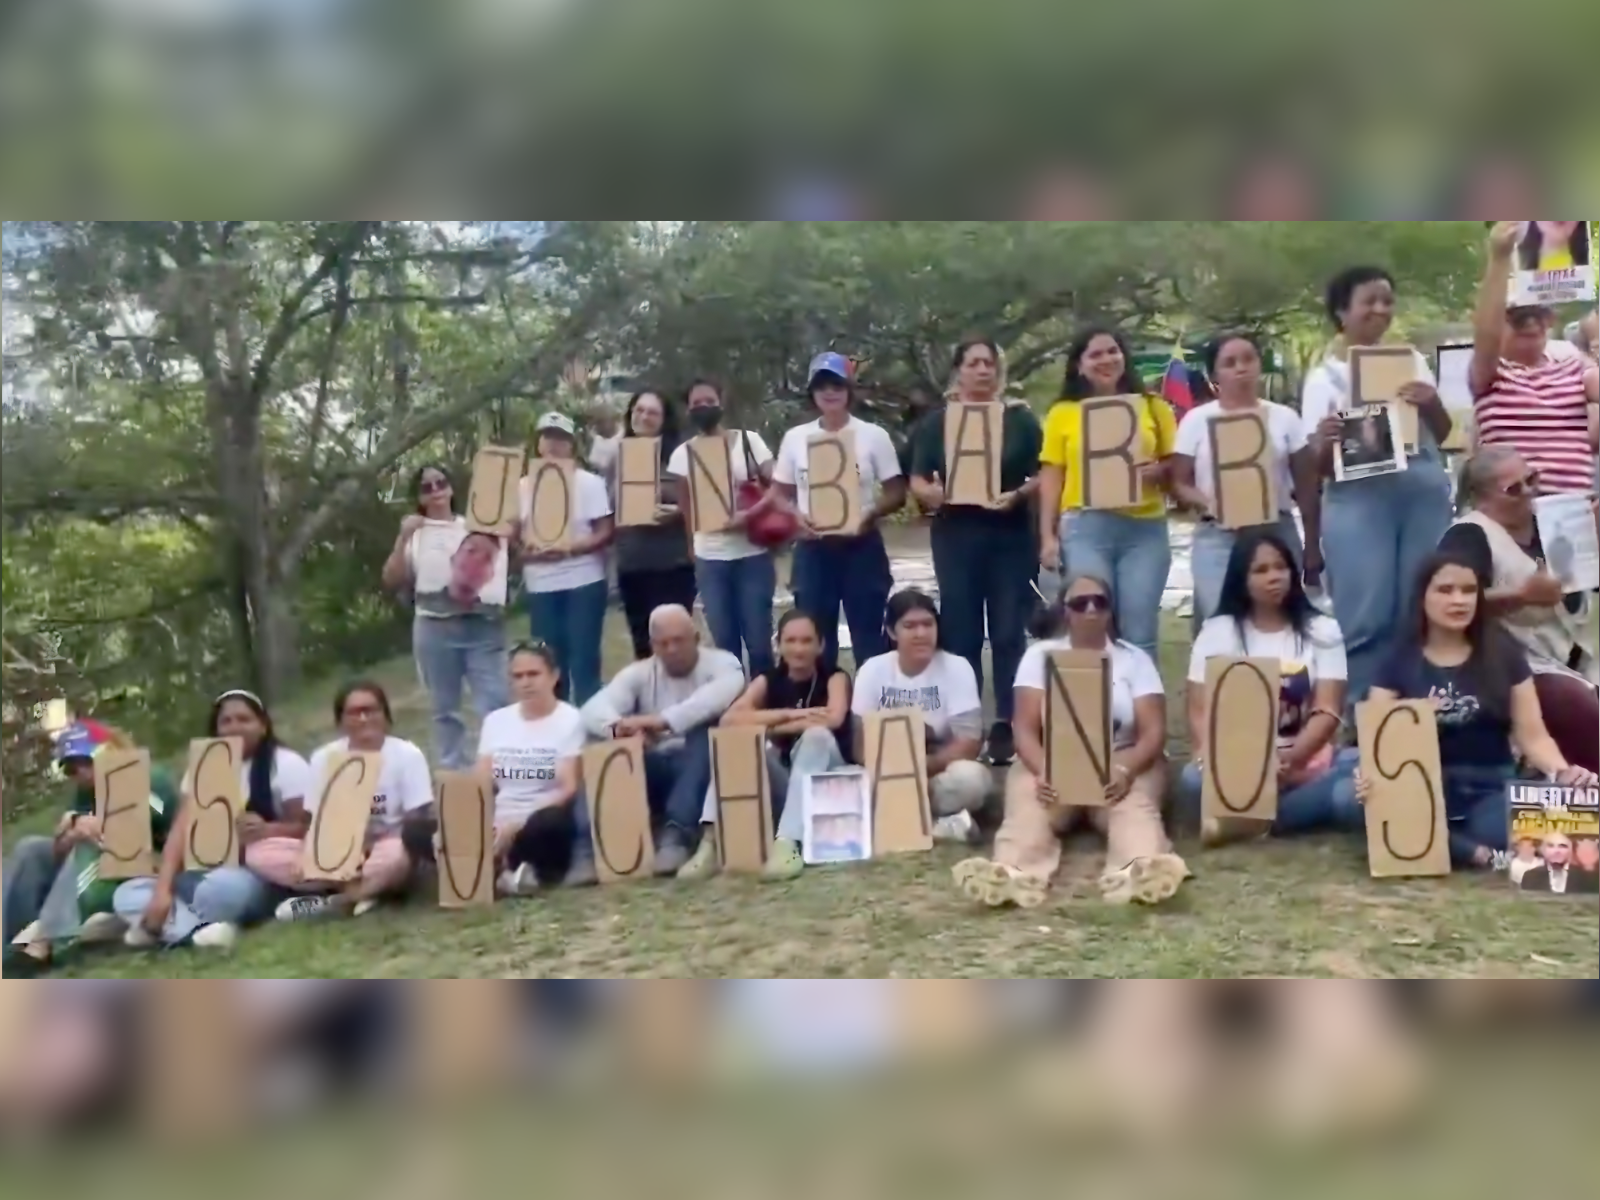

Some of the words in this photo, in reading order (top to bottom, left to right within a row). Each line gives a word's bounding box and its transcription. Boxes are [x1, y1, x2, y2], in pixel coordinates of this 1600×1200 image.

[471, 446, 520, 525] J
[532, 461, 570, 543] O
[616, 440, 661, 525] H
[685, 438, 735, 532] N
[806, 438, 849, 531] B
[946, 404, 995, 504] A
[1082, 399, 1137, 507] R
[1207, 411, 1270, 525] R
[1044, 654, 1111, 796] N
[1209, 660, 1275, 813] O
[1373, 705, 1436, 861] S
[190, 740, 233, 867] S
[314, 755, 366, 873] C
[594, 747, 644, 875] C
[712, 732, 768, 866] H
[871, 714, 932, 856] A
